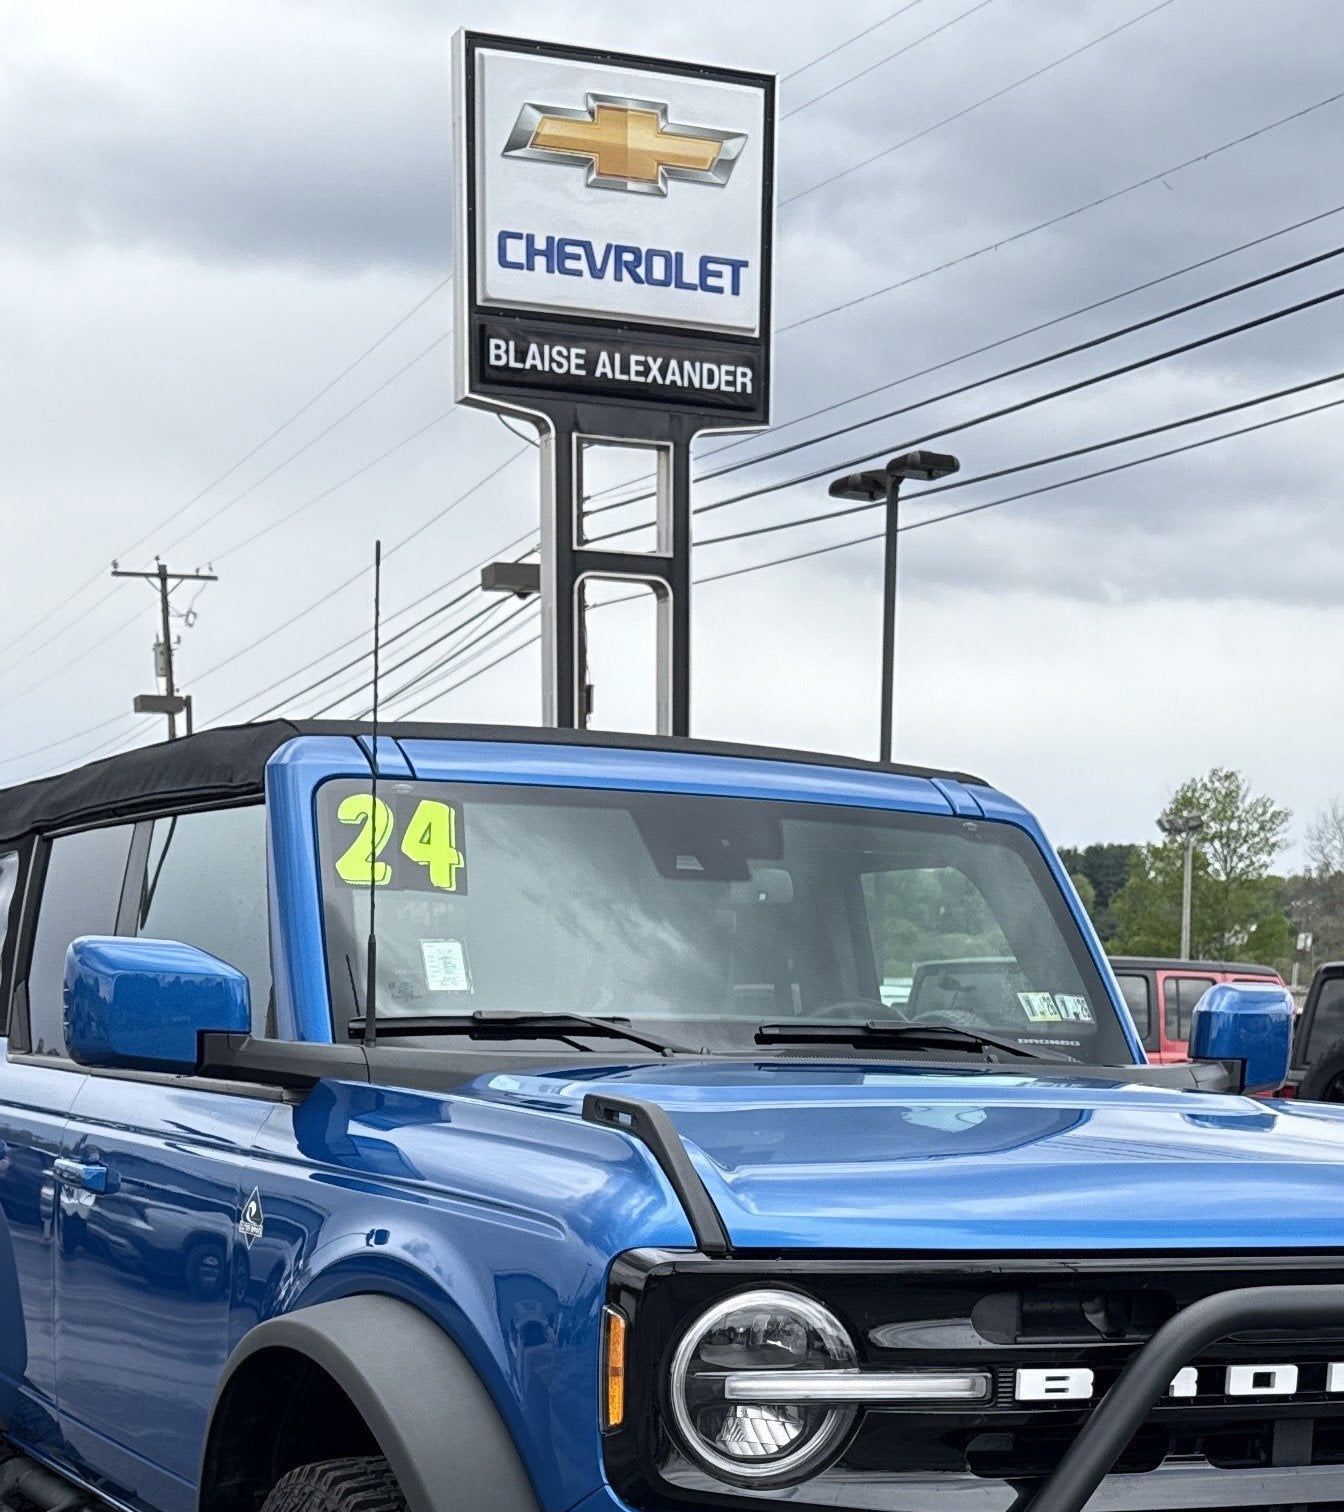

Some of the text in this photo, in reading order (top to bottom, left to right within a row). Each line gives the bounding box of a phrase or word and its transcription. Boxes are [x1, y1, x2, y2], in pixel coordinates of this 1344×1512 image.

[497, 230, 749, 297] CHEVROLET
[488, 338, 754, 394] BLAISE ALEXANDER
[336, 793, 464, 891] 24
